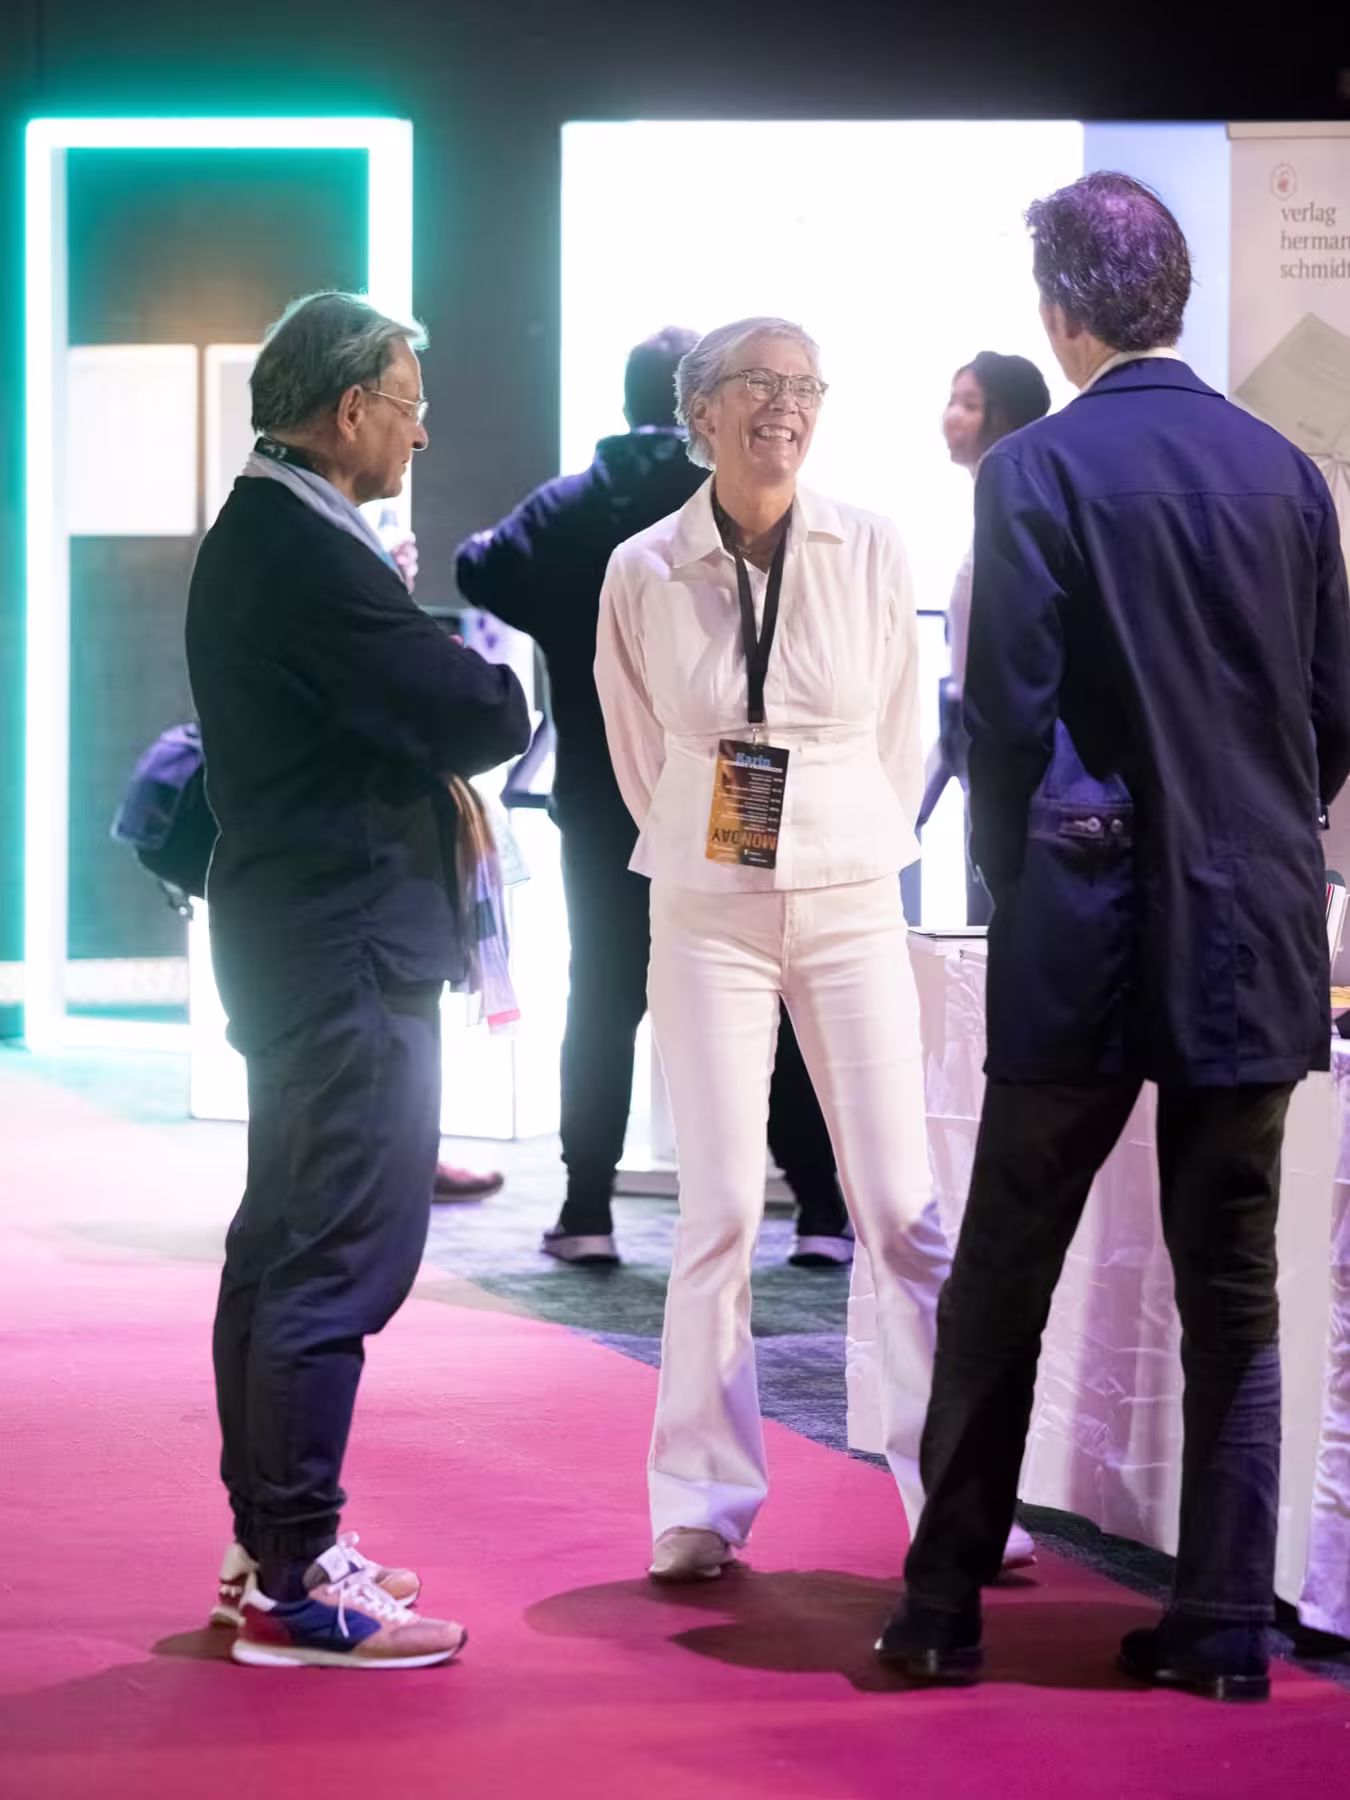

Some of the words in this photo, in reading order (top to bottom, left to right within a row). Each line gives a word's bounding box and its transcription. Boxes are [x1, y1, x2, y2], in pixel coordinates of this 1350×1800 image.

[1282, 202, 1337, 227] verlag
[735, 752, 771, 768] Karin
[711, 828, 777, 850] MONDAY
